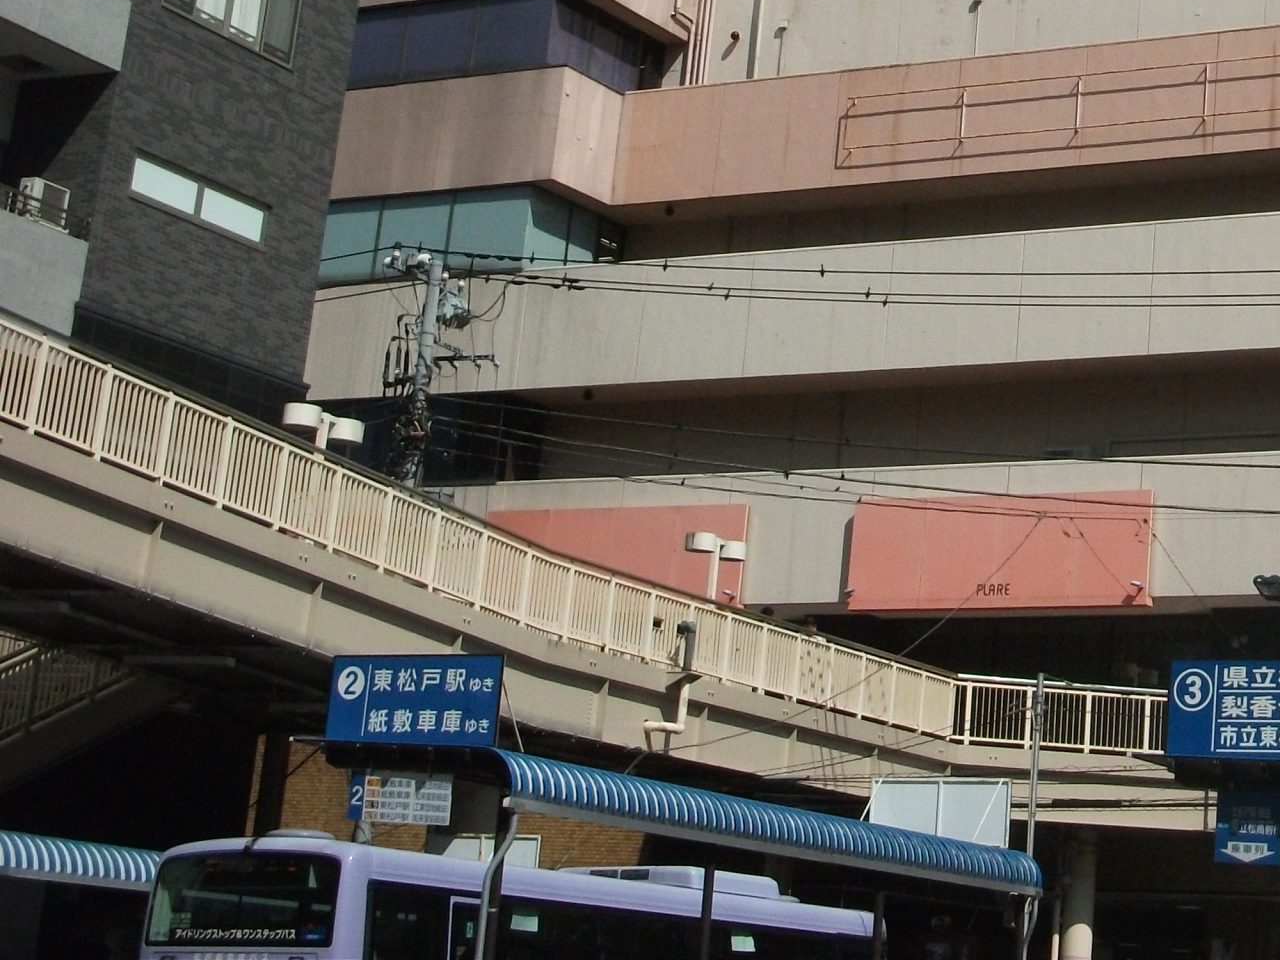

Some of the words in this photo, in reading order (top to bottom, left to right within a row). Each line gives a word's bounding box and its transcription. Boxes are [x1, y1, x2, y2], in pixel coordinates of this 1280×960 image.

[976, 583, 1010, 596] PLARE
[373, 669, 494, 692] 東松戸駅ゆき
[368, 709, 490, 733] 紙敷車庫ゆき
[351, 786, 363, 805] 2
